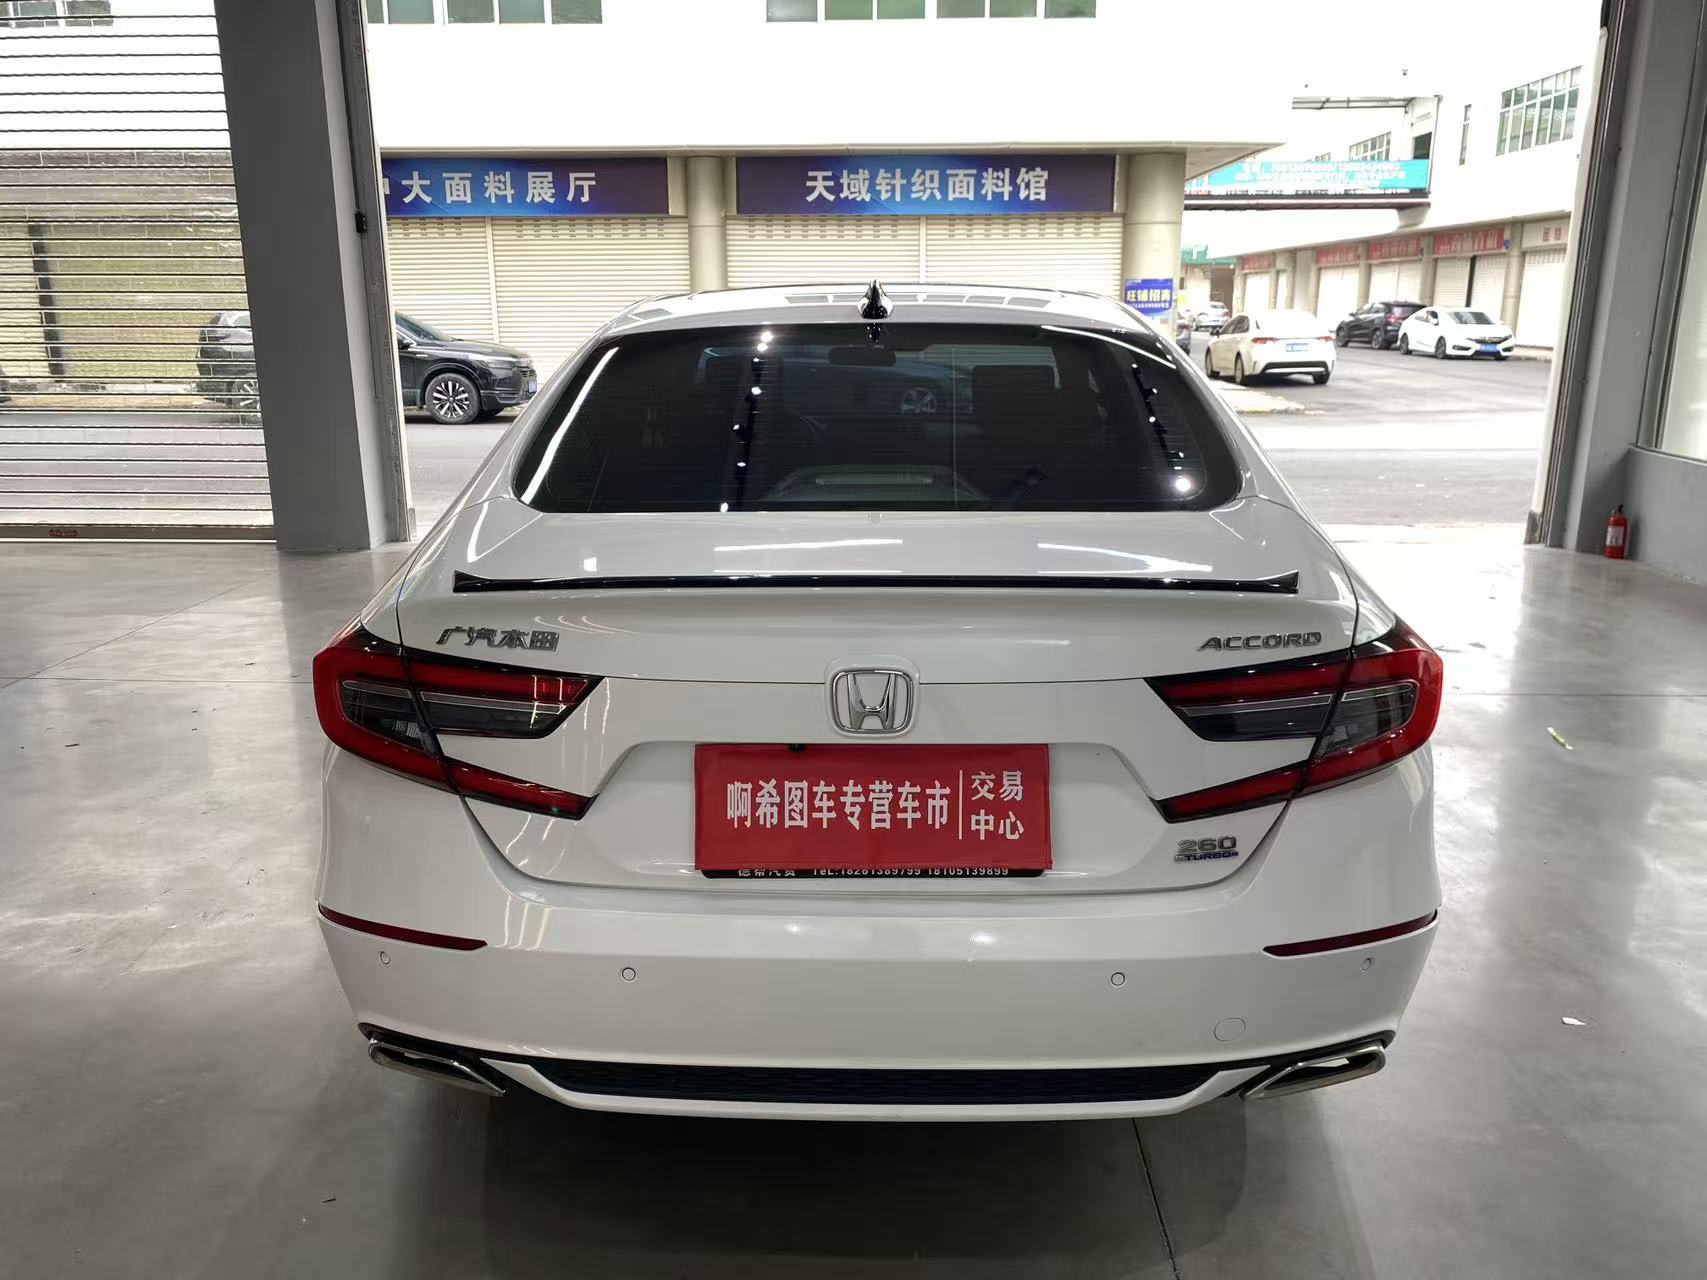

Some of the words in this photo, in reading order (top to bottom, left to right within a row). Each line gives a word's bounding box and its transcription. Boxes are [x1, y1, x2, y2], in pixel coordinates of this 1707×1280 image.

[805, 167, 1050, 203] 天域针织面料馆
[1198, 632, 1322, 652] ACCORD
[970, 770, 1024, 801] 交易
[727, 778, 951, 831] 啊希图车专营车市
[970, 810, 1025, 840] 中心
[1178, 835, 1237, 855] 260
